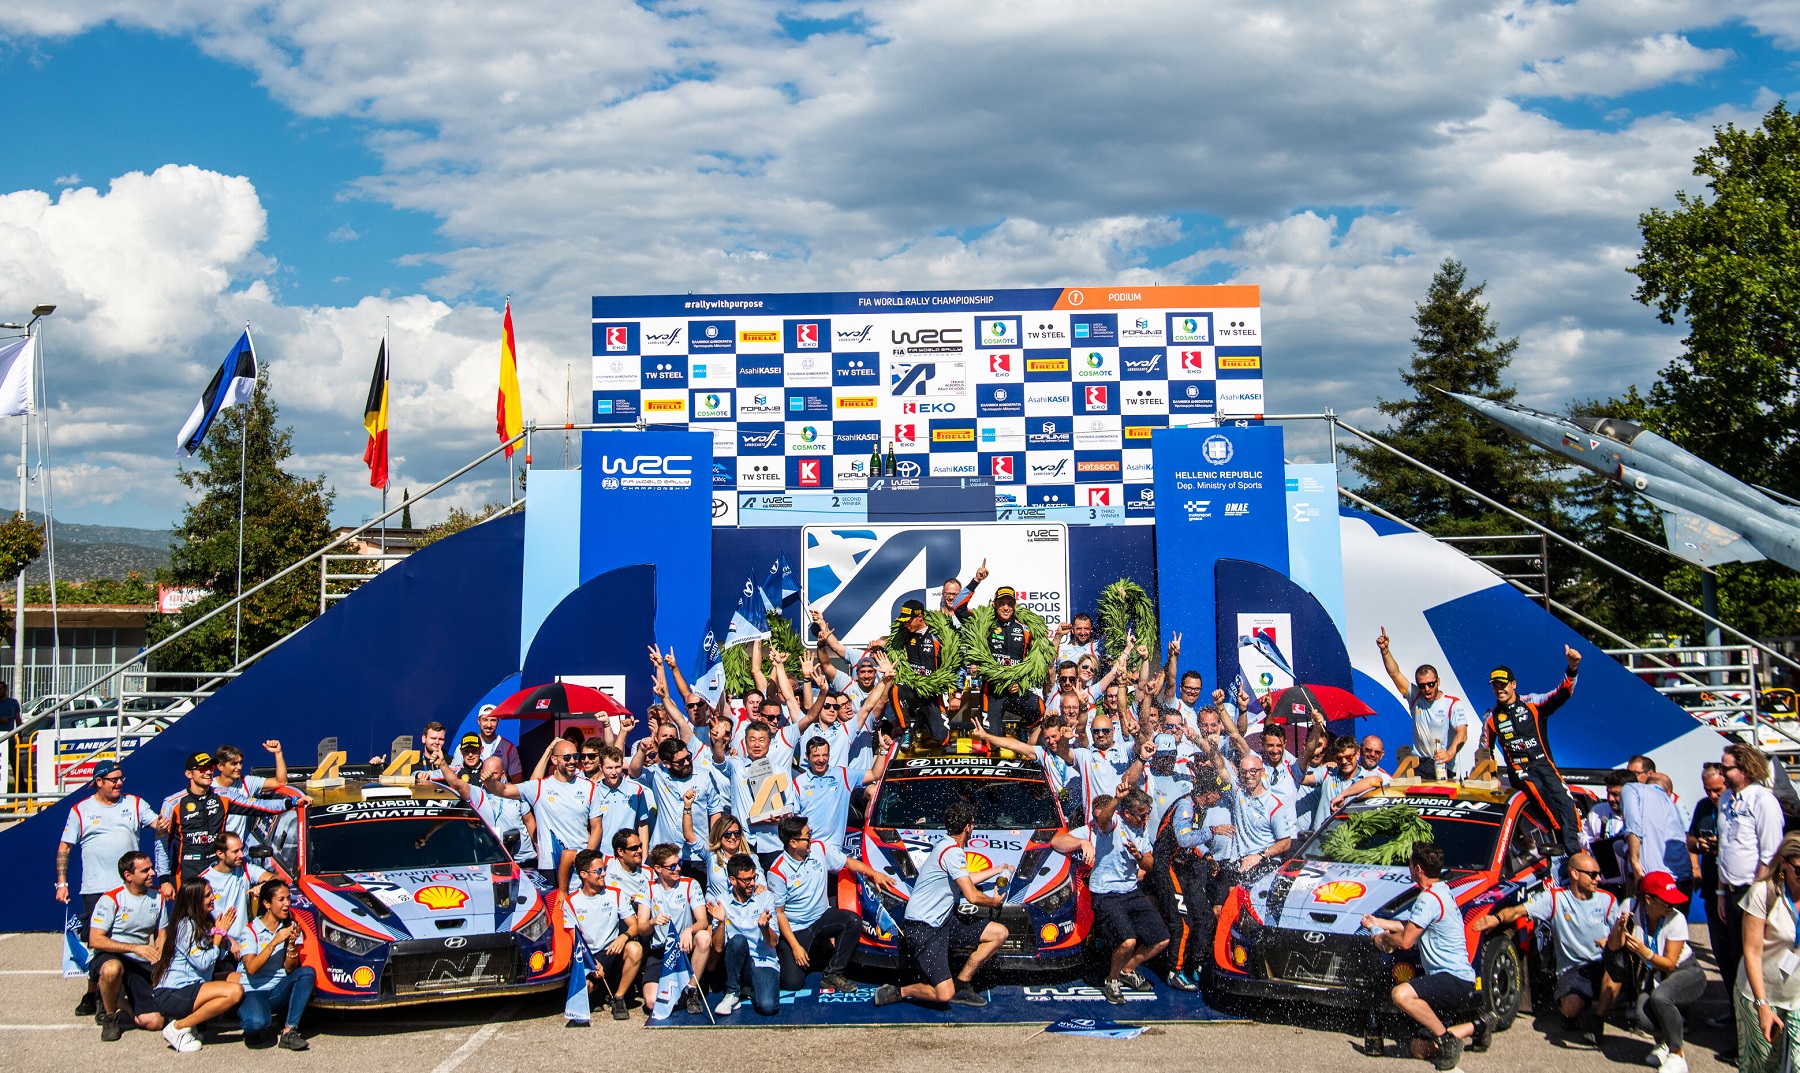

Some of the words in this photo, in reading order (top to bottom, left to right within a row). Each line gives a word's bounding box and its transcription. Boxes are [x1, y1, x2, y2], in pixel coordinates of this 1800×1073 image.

[858, 298, 872, 307] FIA
[874, 297, 905, 306] WORLD
[906, 296, 930, 306] RALLY
[932, 295, 994, 305] CHAMPIONSHIP
[1108, 292, 1142, 302] PODIUM
[684, 299, 764, 310] #rallywithpurpose
[743, 332, 777, 341] PIRELLI
[1041, 331, 1066, 339] STEEL
[1030, 361, 1065, 370] PIRELLI
[1222, 359, 1256, 367] PIRELLI
[659, 371, 684, 379] STEEL
[739, 366, 782, 375] AsahiKASEI
[851, 368, 876, 376] STEEL
[1219, 393, 1262, 401] AsahiKASEI
[648, 401, 682, 410] PIRELLI
[840, 398, 874, 407] PIRELLI
[919, 402, 956, 413] EKO
[936, 431, 971, 440] PIRELLI
[1129, 428, 1152, 437] PIRE
[836, 433, 879, 442] AsahiKASEI
[801, 462, 817, 479] K
[933, 465, 976, 473] AsahiKASEI
[1078, 461, 1119, 471] betsson.
[742, 473, 755, 481] TW
[1175, 471, 1218, 479] HELLENIC
[1219, 471, 1263, 479] REPUBLIC
[1177, 481, 1195, 490] Dep.
[1197, 481, 1226, 490] Ministry
[1228, 481, 1236, 490] of
[1238, 481, 1263, 490] Sports
[831, 496, 840, 508] 2
[1225, 502, 1249, 512] OMAE
[1089, 508, 1097, 520] 3
[1029, 591, 1060, 600] EKO
[1020, 602, 1061, 612] OPOLIS
[934, 757, 993, 766] HYUNDAI
[918, 767, 1012, 776] FANATEC
[356, 799, 420, 809] HYUNDAI
[1391, 797, 1453, 807] HYUNDAI
[344, 808, 442, 821] FANATEC
[1418, 807, 1468, 818] ATEC
[964, 838, 1023, 851] OBIS
[408, 872, 489, 884] MOBIS
[1339, 869, 1415, 885] MOBIS
